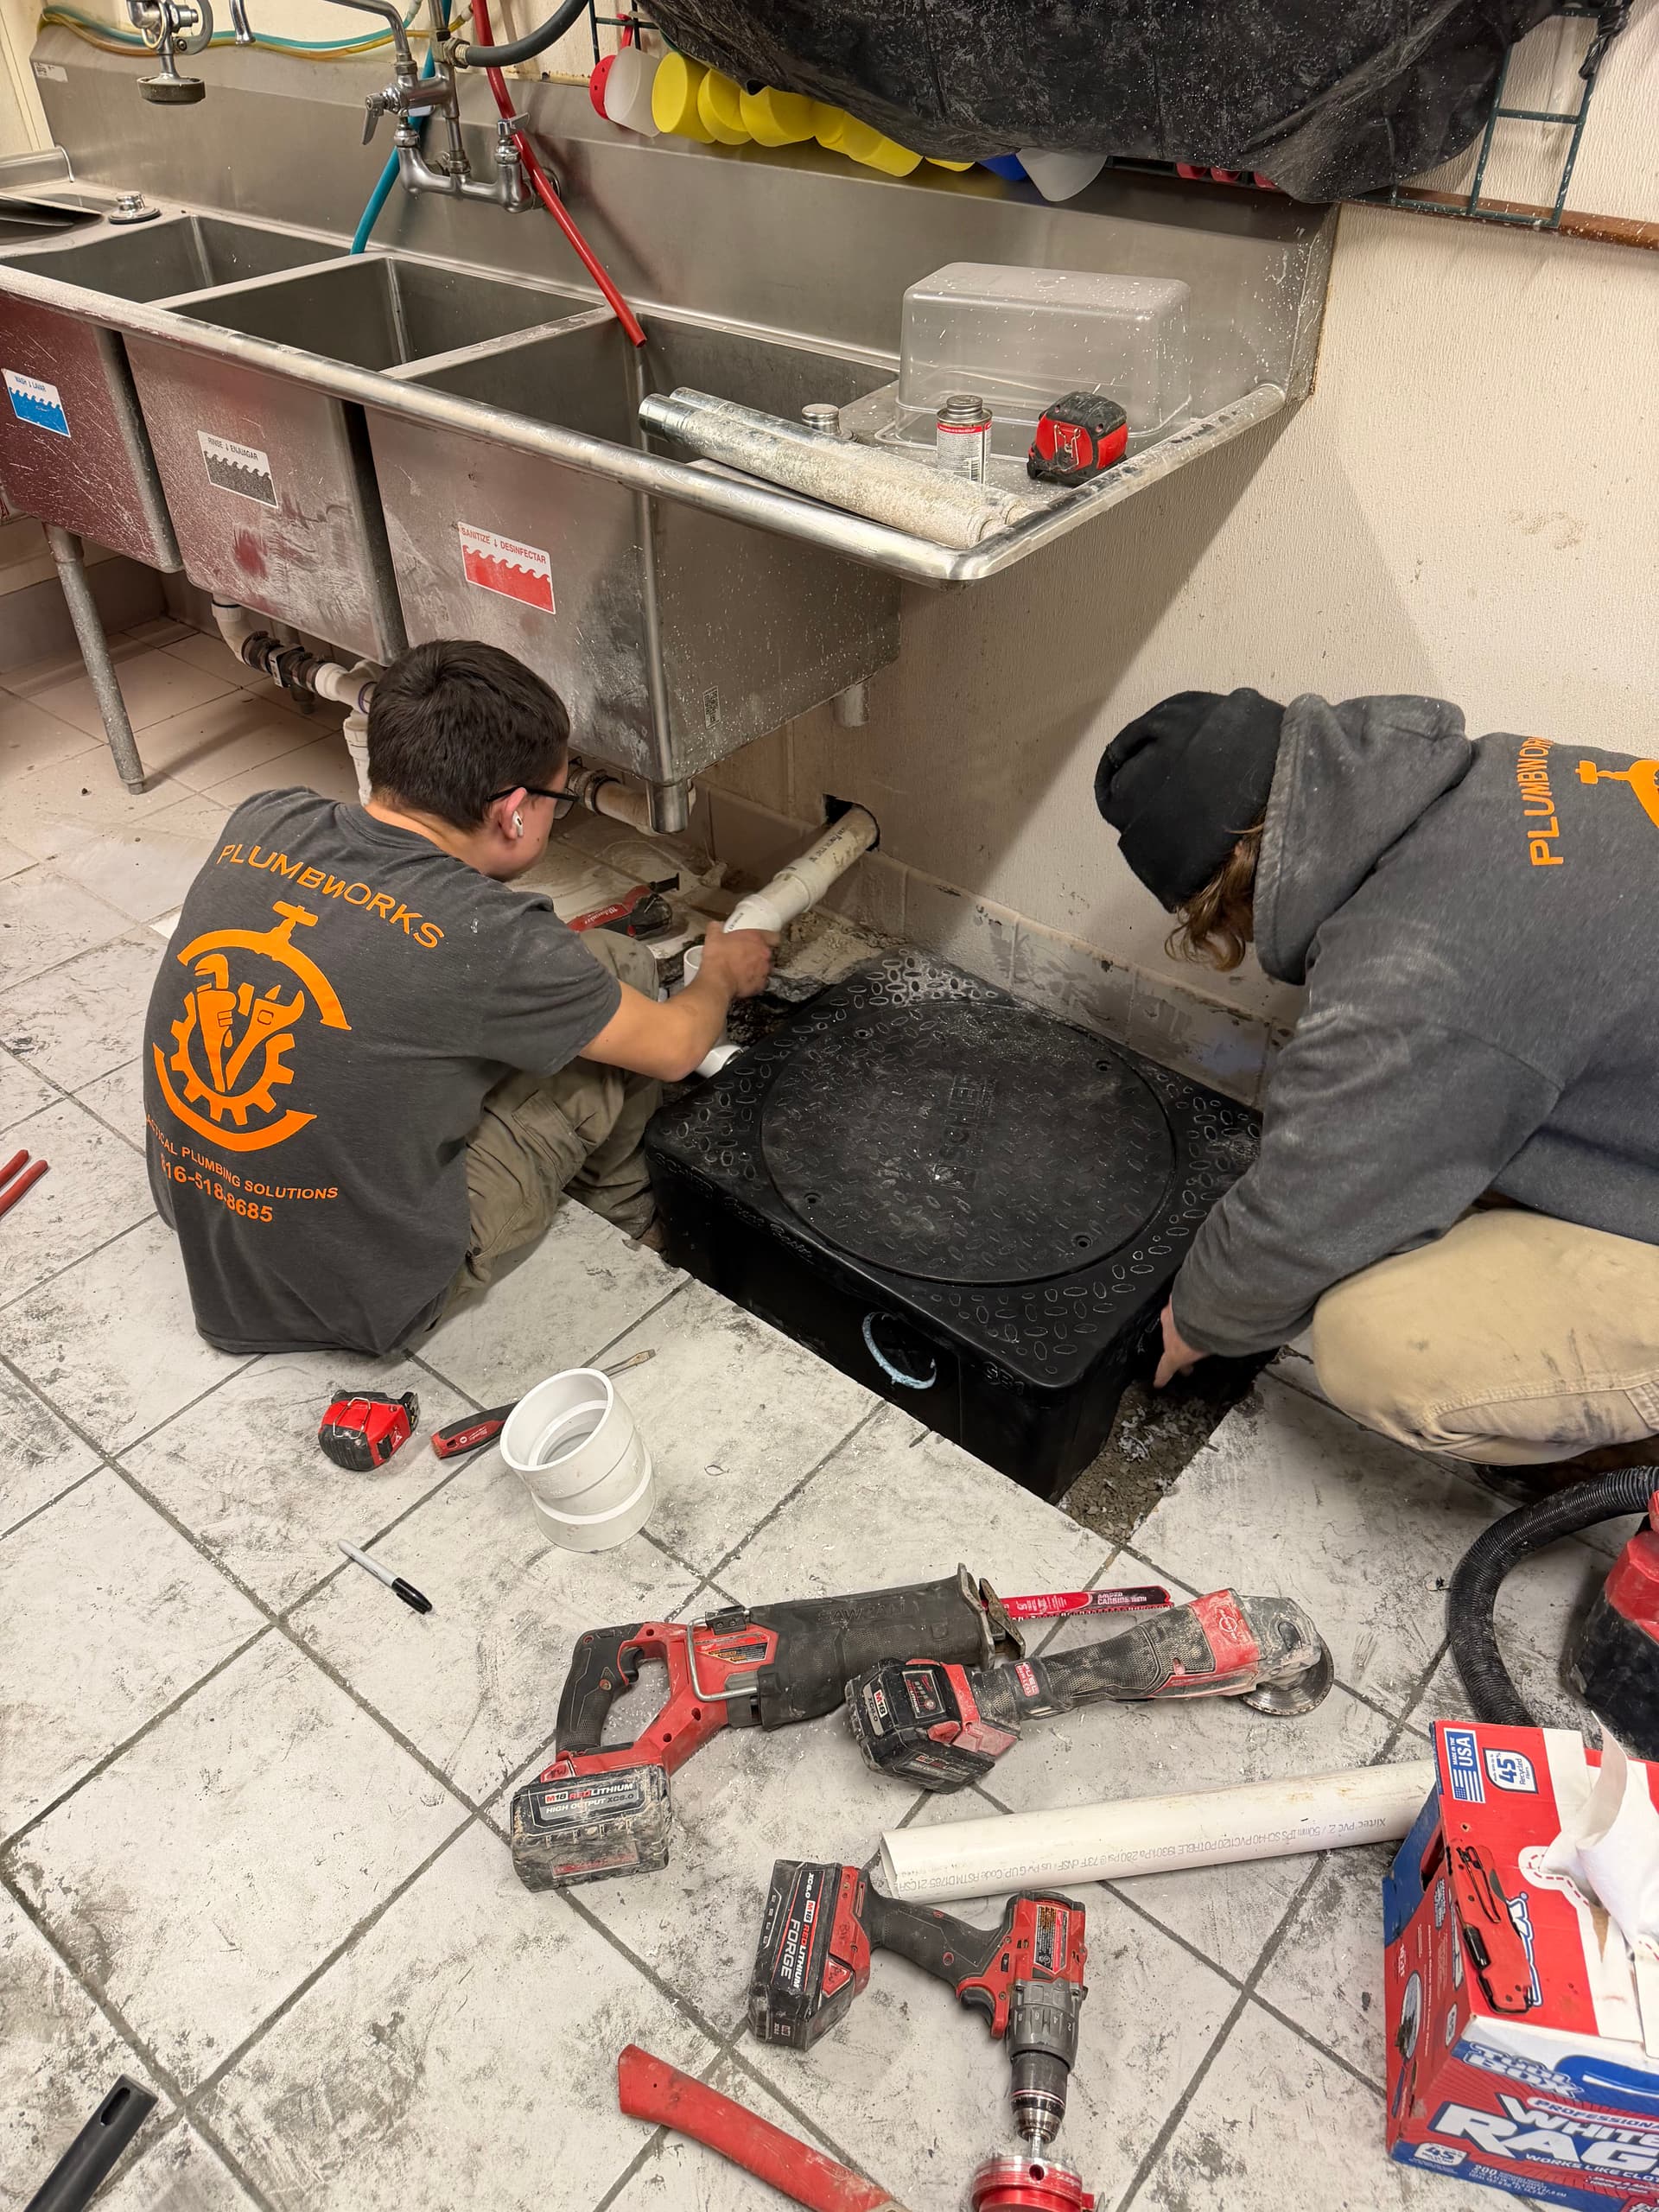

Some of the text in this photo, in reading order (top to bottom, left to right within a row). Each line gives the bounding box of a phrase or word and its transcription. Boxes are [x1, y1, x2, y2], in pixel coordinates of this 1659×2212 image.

[207, 437, 223, 448] RINSE
[461, 527, 546, 563] SANITIZE DESINFECTAR
[1516, 736, 1564, 866] PLUMBWOR
[216, 843, 445, 948] PLUMBWORKS
[181, 1147, 241, 1187] PLUMBING
[244, 1180, 339, 1199] SOLUTIONS
[875, 1692, 887, 1717] M18
[1457, 1737, 1474, 1767] USA
[1516, 1758, 1526, 1785] Recycled
[546, 1783, 634, 1803] M18 REDLITHIUM
[546, 1804, 569, 1815] HIGH
[570, 1797, 607, 1809] OUTPUT
[1338, 1822, 1355, 1834] PVC
[804, 1901, 815, 1922] M18
[781, 1918, 801, 1979] FORGE
[793, 1923, 810, 1989] REDLITHIUM
[1499, 2093, 1659, 2147] WHITE
[1434, 2103, 1659, 2176] RAG
[1473, 2164, 1497, 2176] 200
[1525, 2153, 1582, 2169] WORKS
[1585, 2164, 1620, 2175] LIKE
